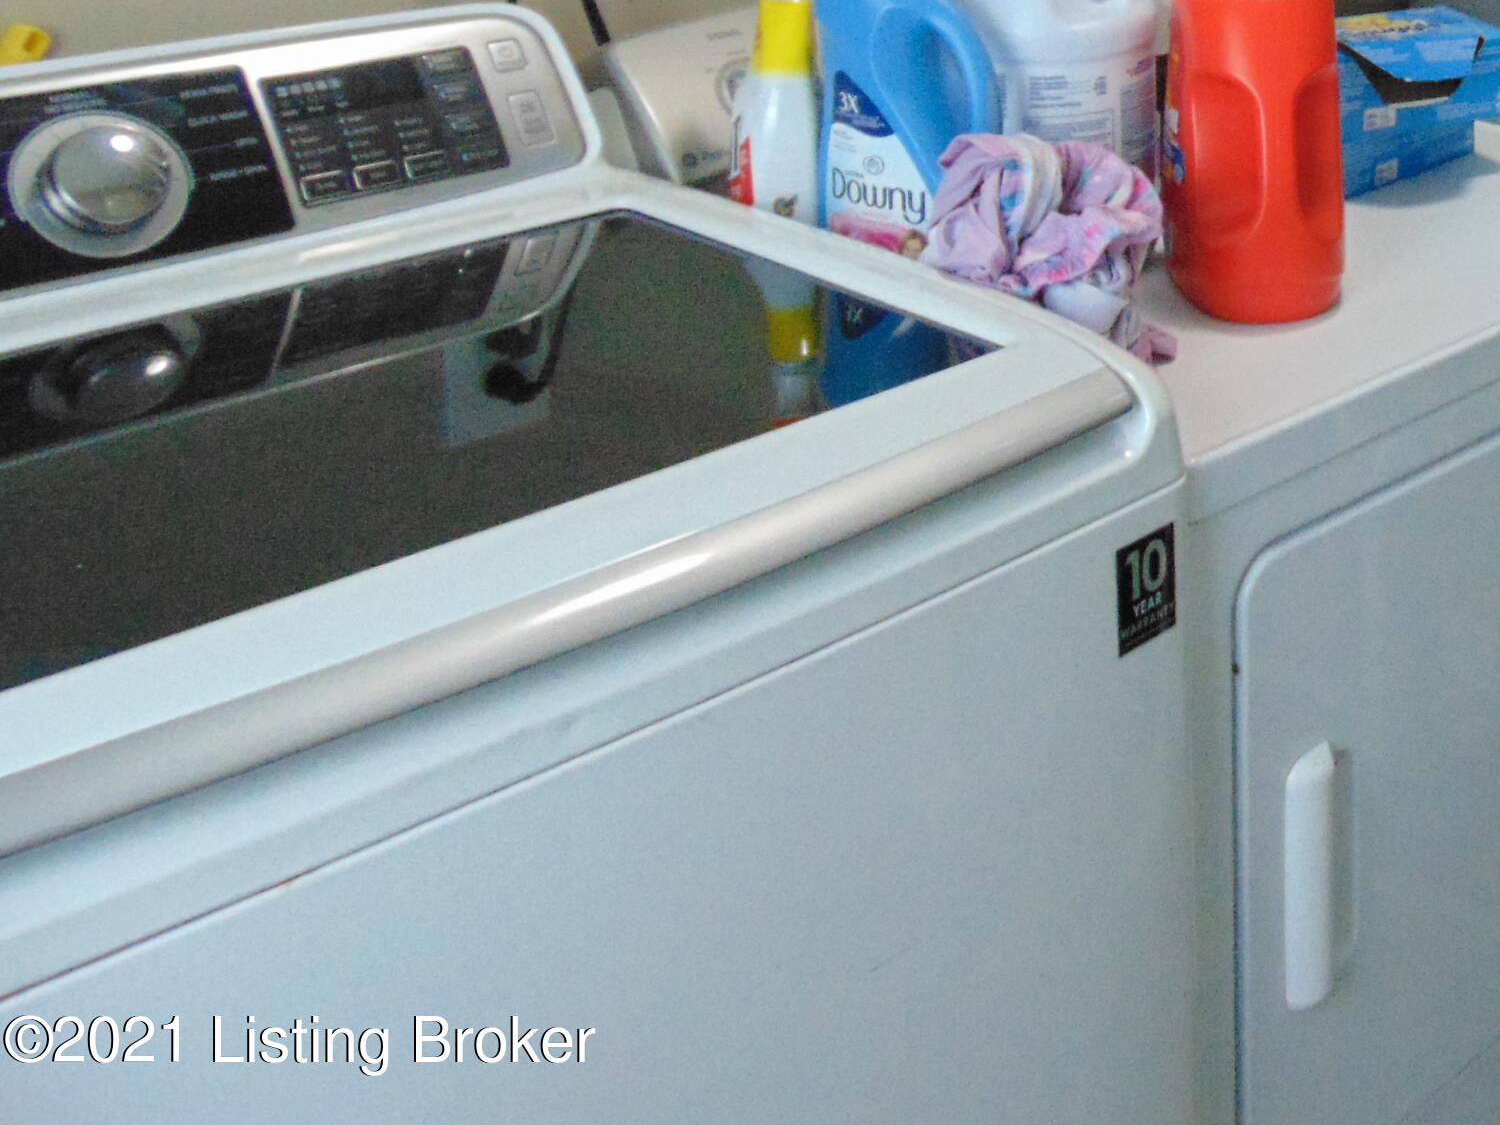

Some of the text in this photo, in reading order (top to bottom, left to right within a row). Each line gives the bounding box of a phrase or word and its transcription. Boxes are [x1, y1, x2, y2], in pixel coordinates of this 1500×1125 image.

[838, 91, 860, 113] 3X
[831, 168, 927, 226] Downy
[1124, 538, 1168, 600] 10
[1132, 591, 1163, 616] YEAR
